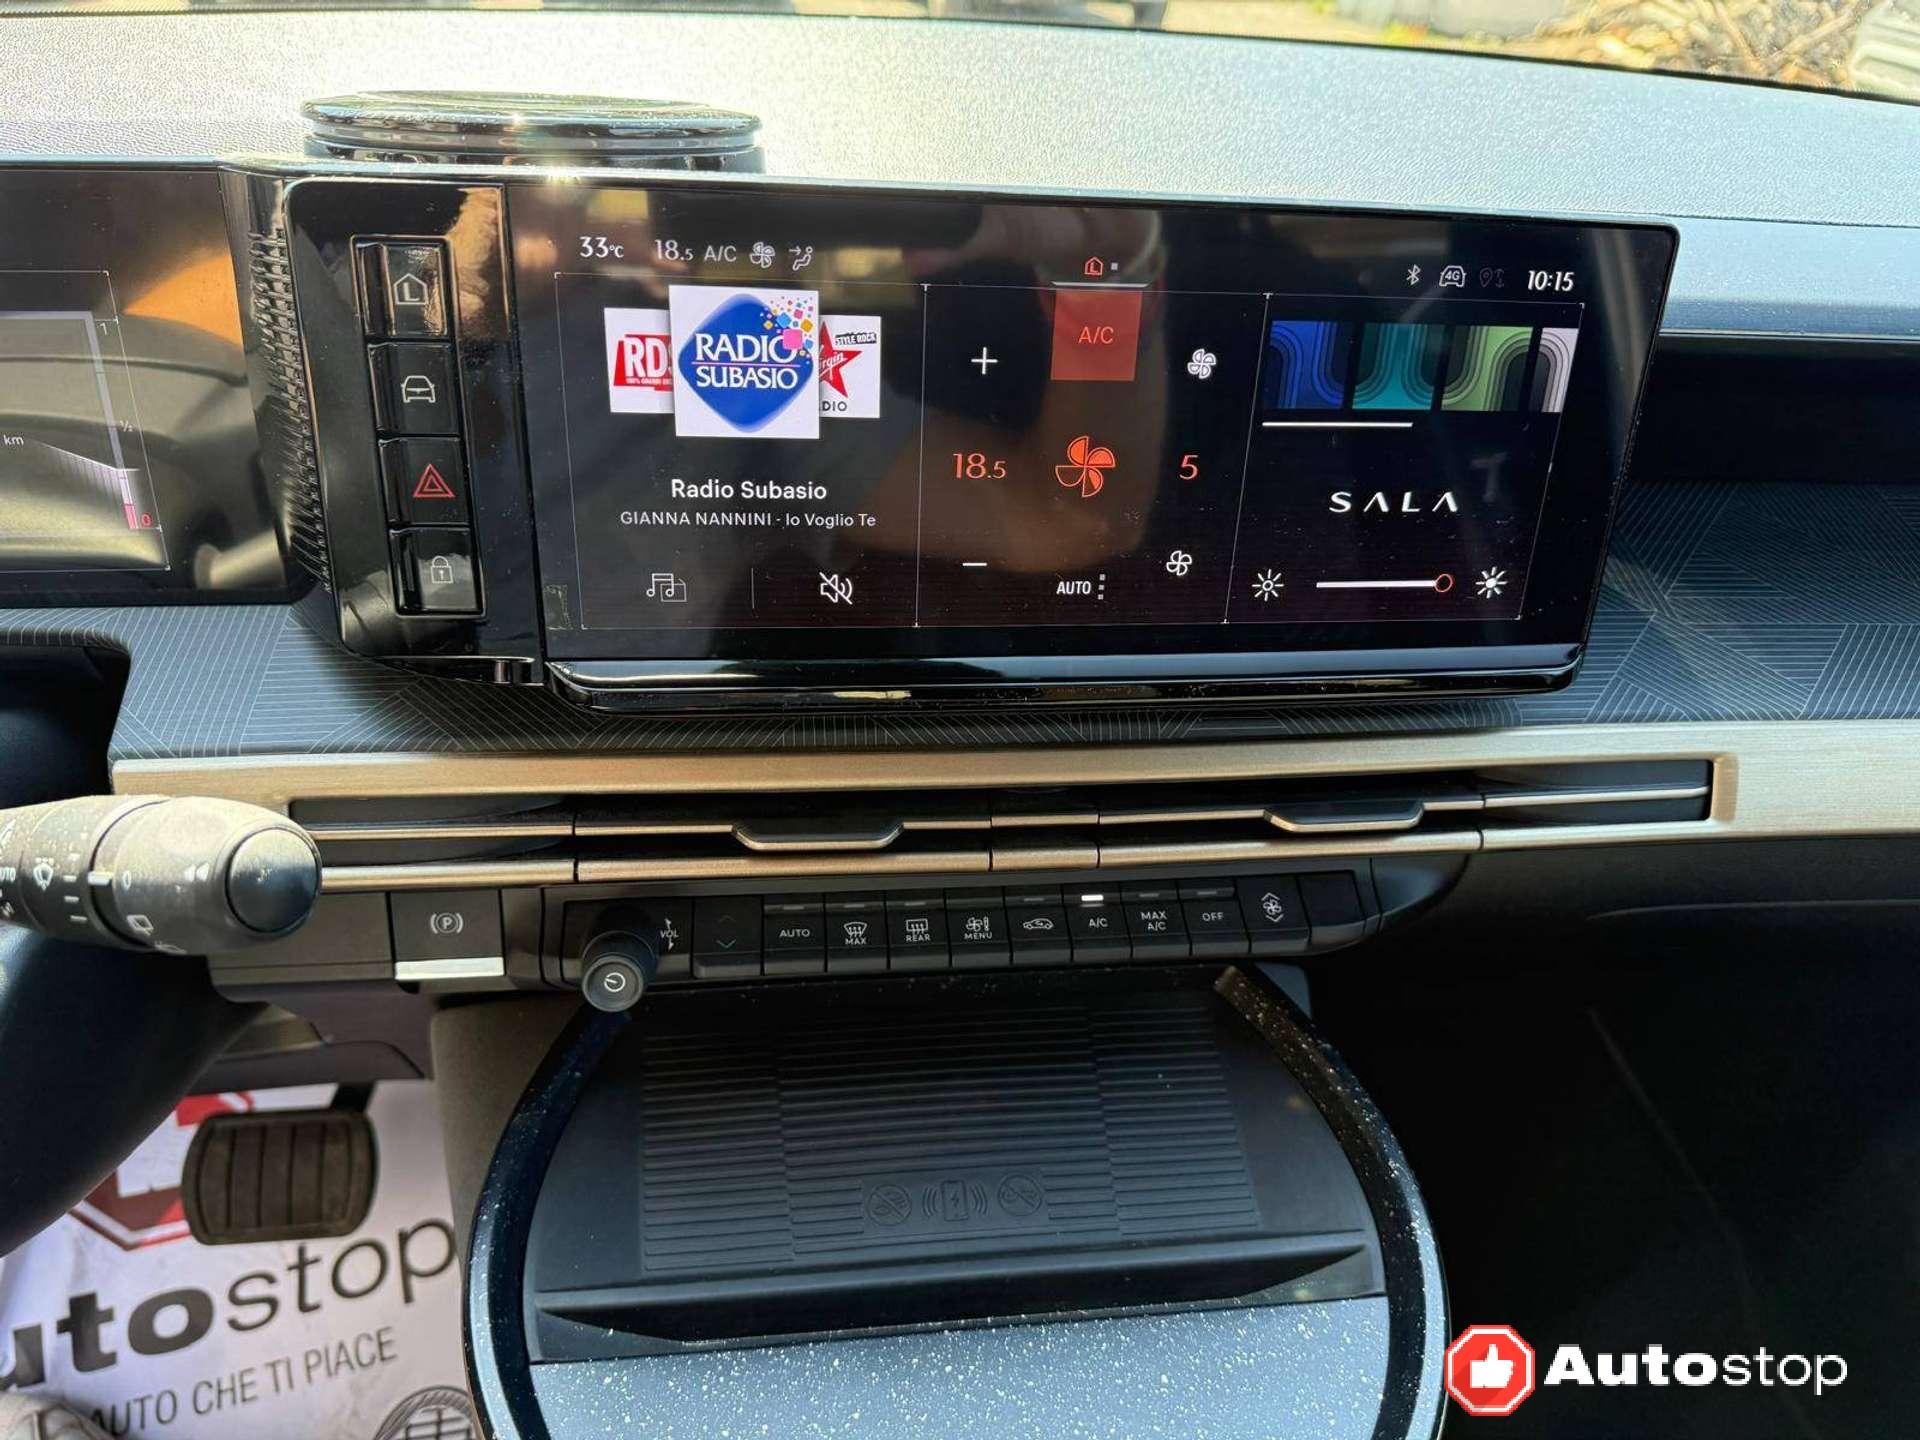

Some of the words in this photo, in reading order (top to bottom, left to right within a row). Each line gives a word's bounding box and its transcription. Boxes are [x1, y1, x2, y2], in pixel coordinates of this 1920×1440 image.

[654, 239, 694, 262] 18.5
[704, 245, 737, 263] A/C
[1444, 270, 1460, 281] 4G
[1527, 270, 1575, 292] 10:15
[1078, 326, 1114, 344] A/C
[695, 332, 798, 364] RADIO
[624, 336, 673, 379] RD
[696, 366, 799, 390] SUBASIO
[821, 400, 848, 412] DIO
[3, 434, 24, 446] km
[952, 452, 1007, 480] 18.5
[1178, 454, 1199, 480] 5
[671, 478, 735, 499] Radio
[740, 480, 828, 500] Subasio
[1328, 491, 1459, 513] SALA
[620, 511, 691, 526] GIANNA
[695, 512, 772, 527] NANNINI
[804, 513, 854, 530] Voglio
[858, 513, 877, 527] Te
[1056, 580, 1092, 596] AUTO
[1088, 917, 1109, 929] A/C
[1140, 910, 1168, 922] MAX
[1202, 911, 1224, 922] OFF
[660, 927, 680, 939] VOL
[779, 927, 811, 939] AUTO
[1147, 920, 1167, 932] A/C
[844, 935, 868, 946] MAX
[905, 932, 931, 943] REAR
[964, 930, 993, 941] MENU
[192, 1370, 260, 1416] CHE
[264, 1357, 294, 1393] TI
[304, 1325, 399, 1385] PIACE
